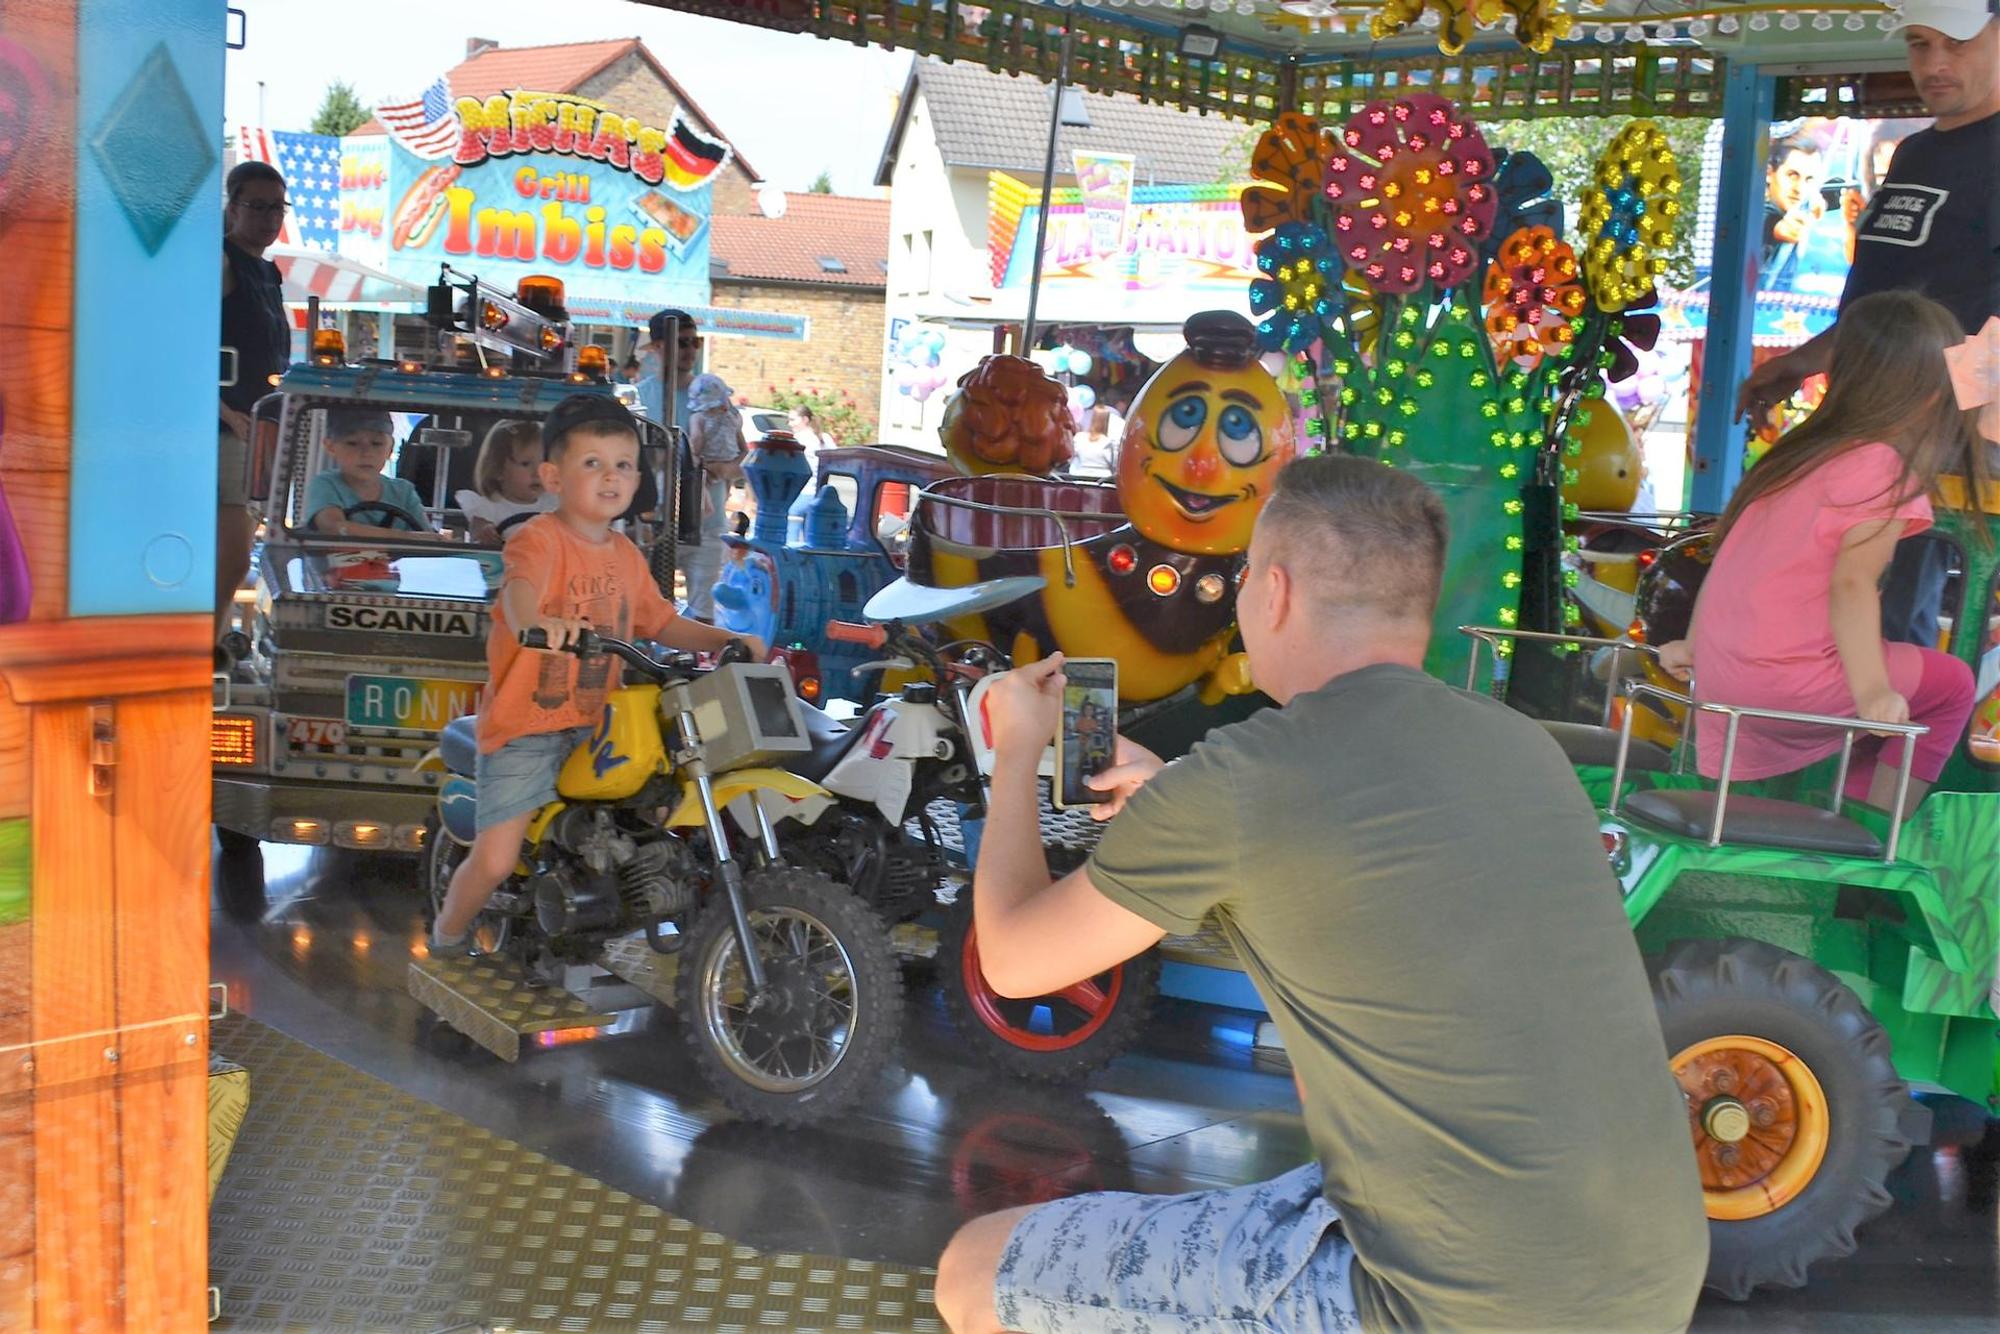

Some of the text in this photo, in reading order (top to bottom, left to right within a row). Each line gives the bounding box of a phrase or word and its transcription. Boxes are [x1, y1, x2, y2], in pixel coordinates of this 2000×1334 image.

[514, 166, 592, 203] Grill
[443, 186, 668, 273] Imbiss
[329, 606, 471, 635] SCANIA
[291, 720, 344, 744] 470
